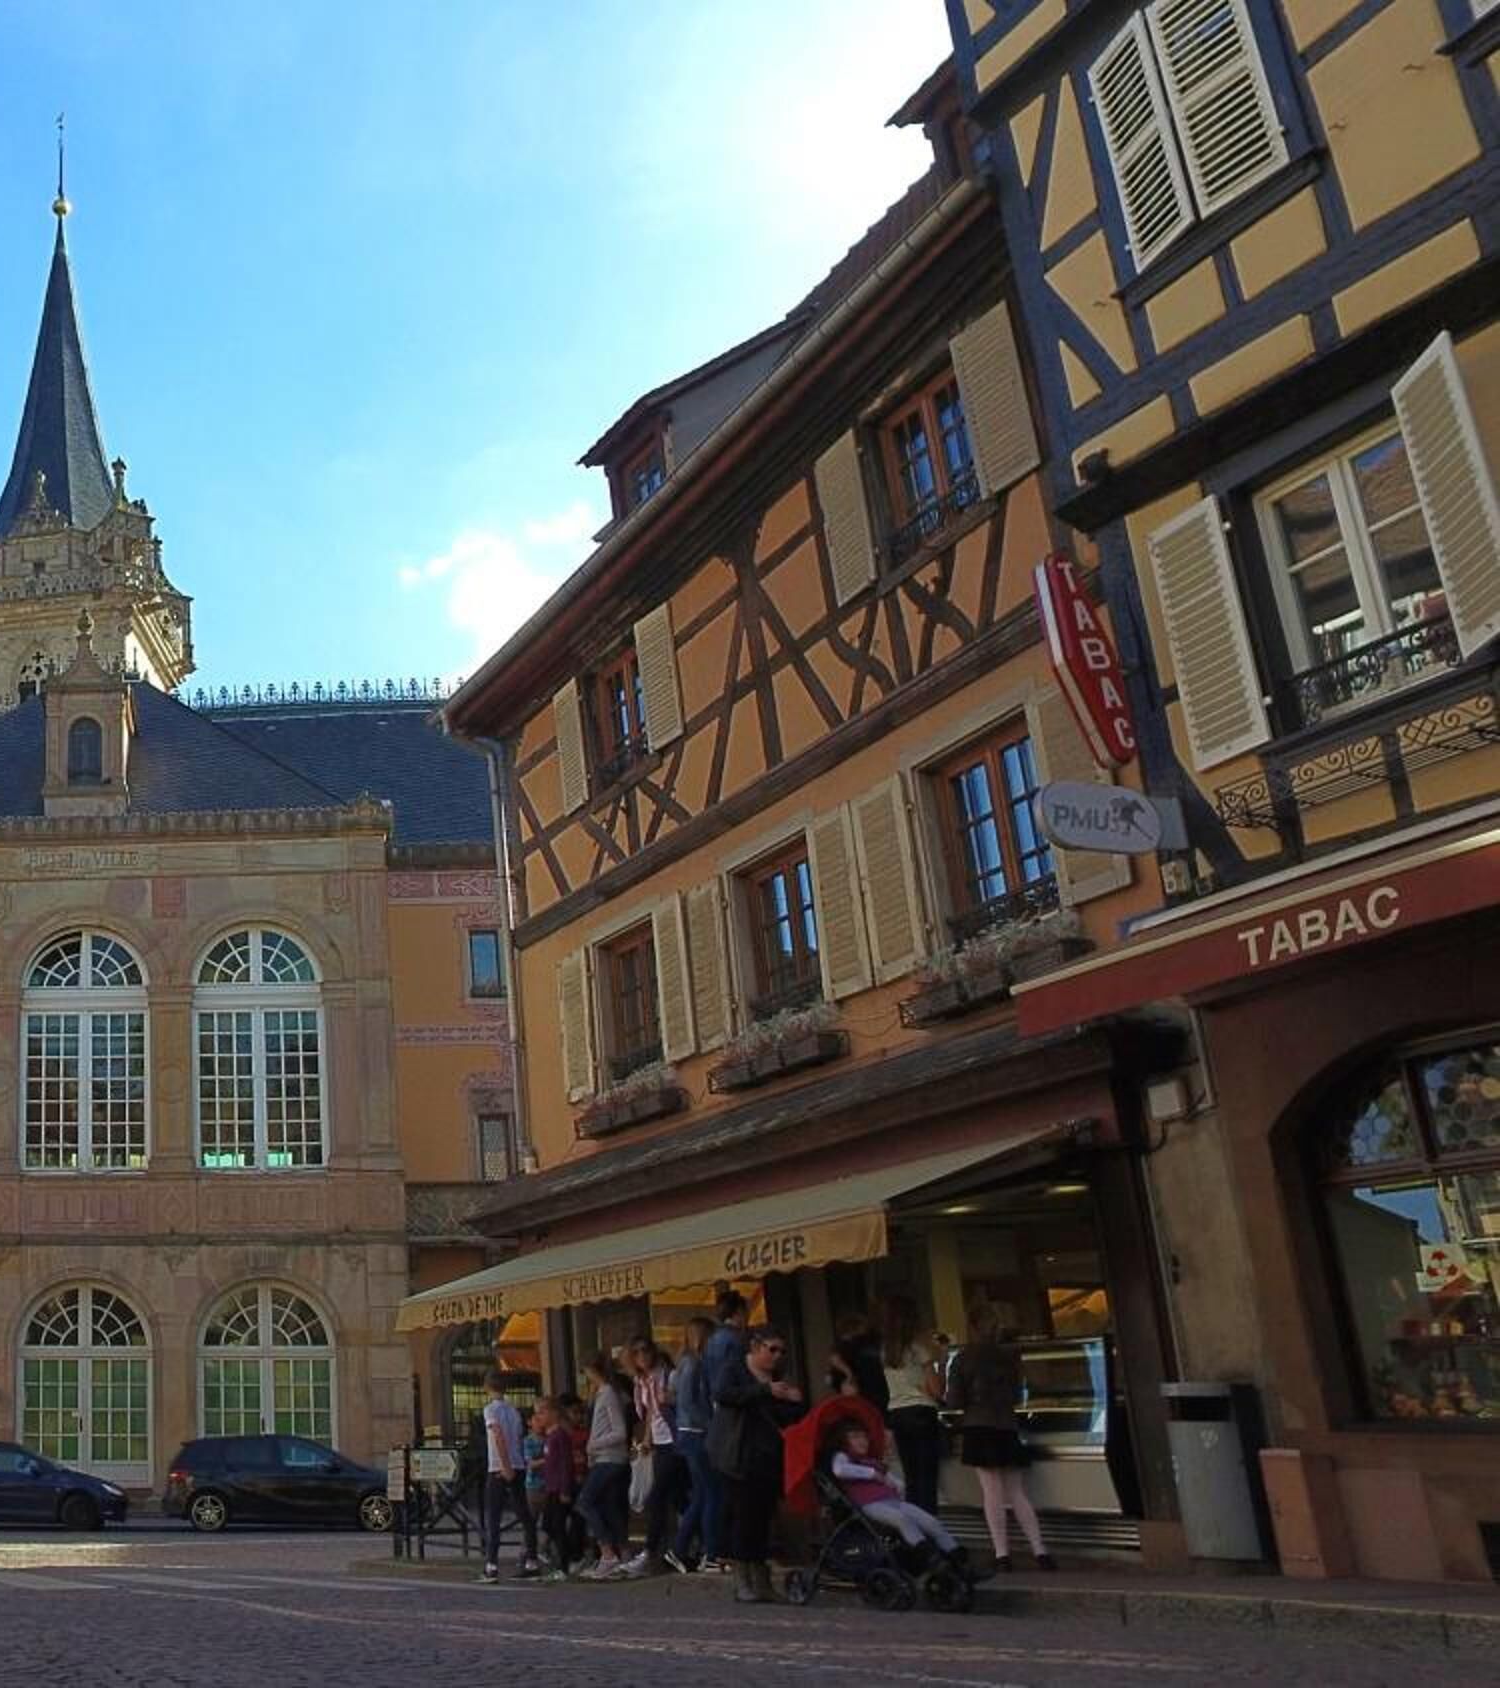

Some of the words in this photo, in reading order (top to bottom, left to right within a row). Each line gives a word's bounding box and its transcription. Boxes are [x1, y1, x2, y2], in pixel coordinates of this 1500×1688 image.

[1057, 562, 1135, 749] TABAC
[1053, 803, 1110, 831] PMU
[1237, 886, 1400, 966] TABAC
[563, 1265, 645, 1299] SCHAEFFER
